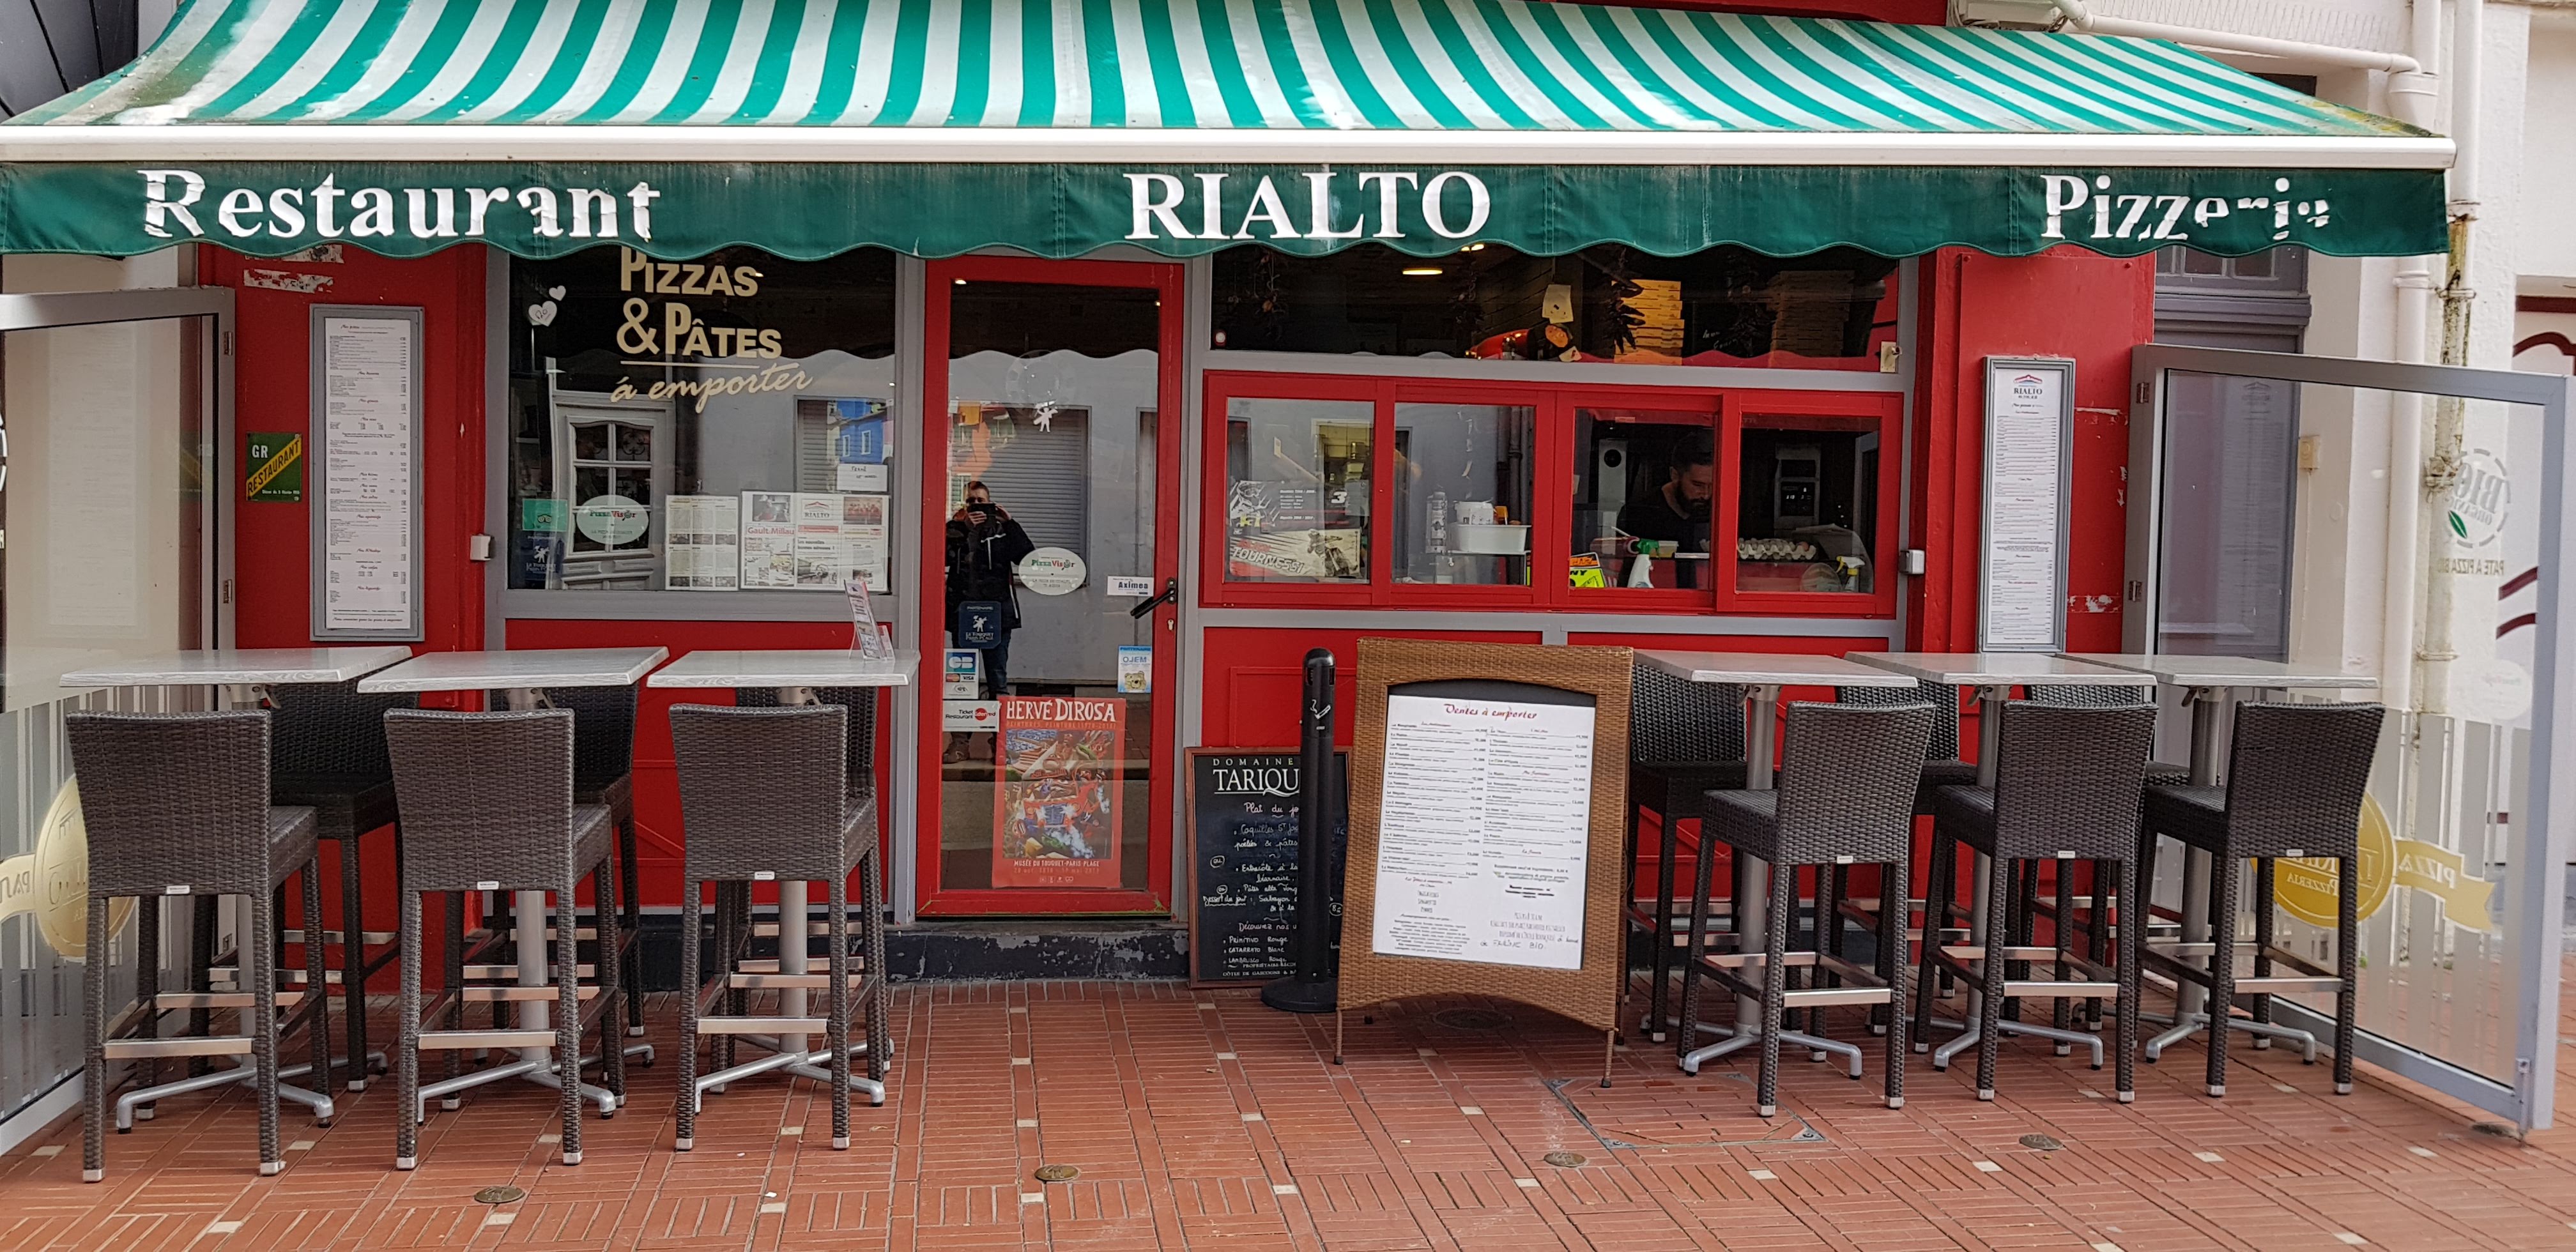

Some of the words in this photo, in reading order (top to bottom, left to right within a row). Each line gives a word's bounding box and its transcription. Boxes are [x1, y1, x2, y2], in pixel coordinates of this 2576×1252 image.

[136, 168, 661, 243] Restaurant
[1123, 171, 1491, 240] RIALTO
[616, 298, 660, 355] &
[665, 302, 782, 359] PÂTES
[648, 363, 813, 414] emporter
[248, 439, 300, 496] RESTAURANT
[252, 445, 268, 458] GR
[1006, 699, 1053, 720] HERVÉ
[1055, 698, 1117, 722] DIROSA
[1213, 758, 1294, 767] DOMAINE
